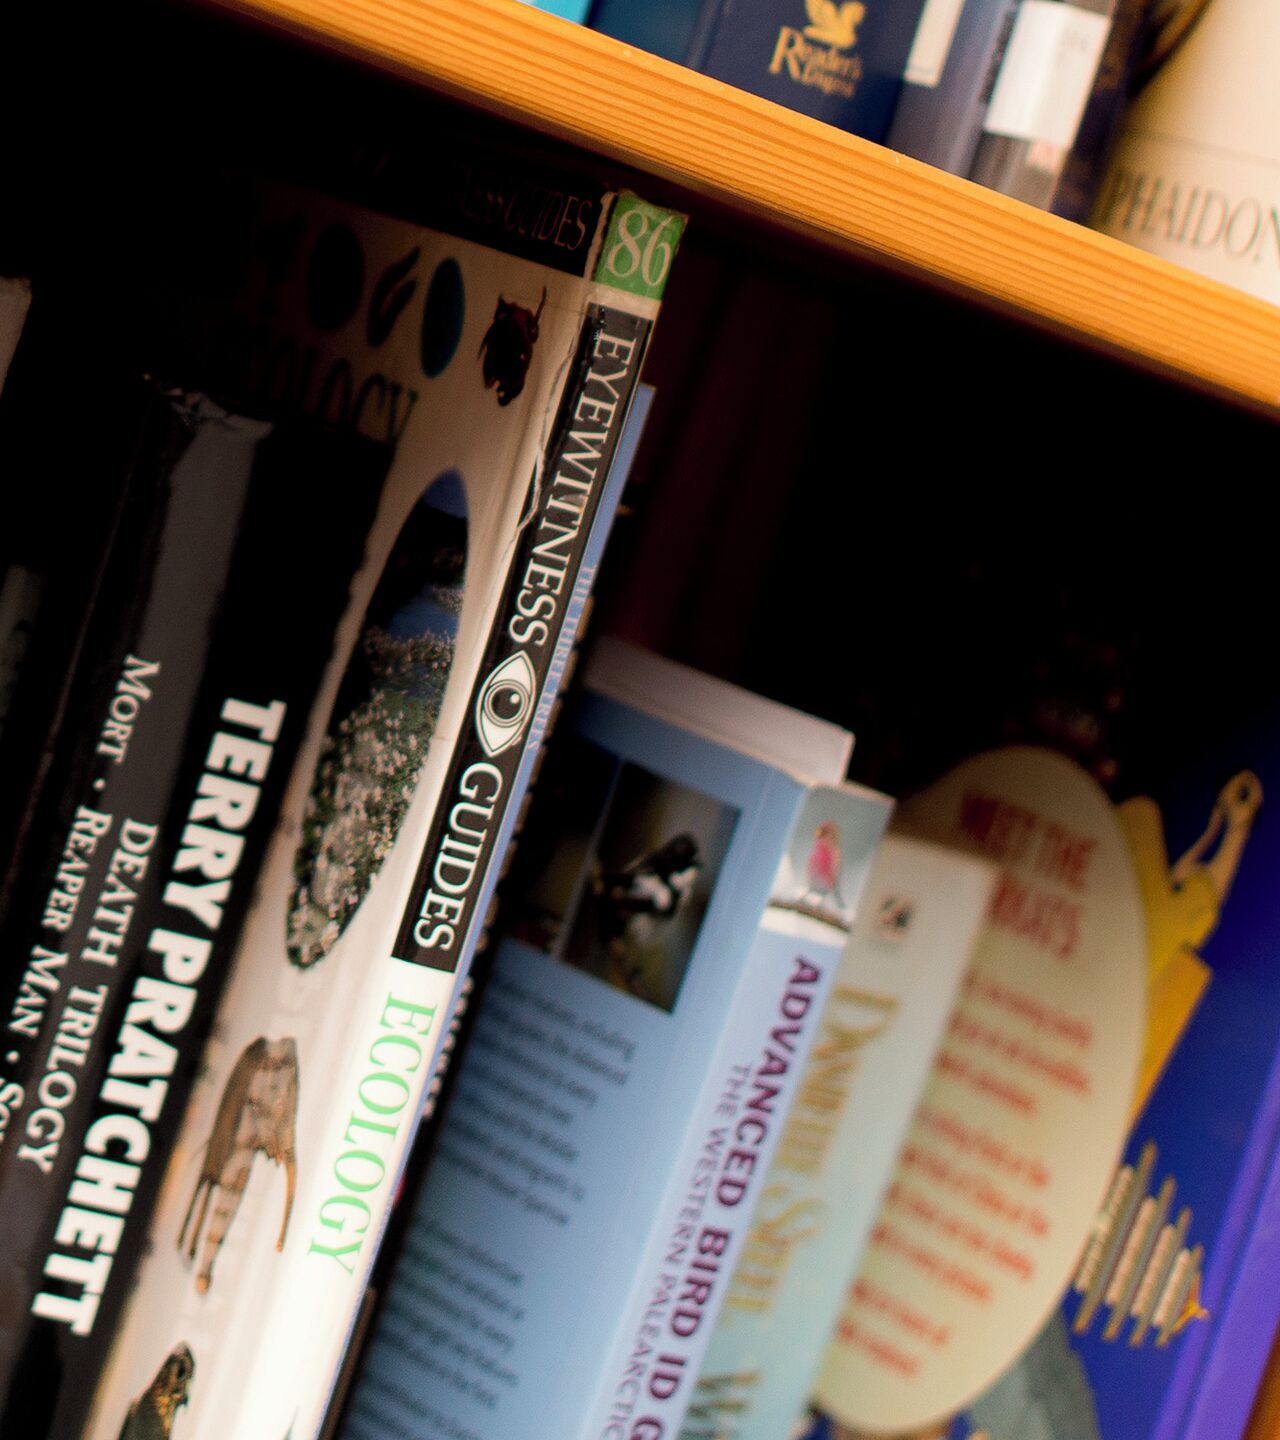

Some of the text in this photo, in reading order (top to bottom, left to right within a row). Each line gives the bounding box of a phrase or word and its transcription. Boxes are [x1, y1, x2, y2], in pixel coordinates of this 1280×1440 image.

[604, 208, 673, 287] 86
[413, 328, 639, 951] EYEWITNESS GUIDES
[17, 817, 159, 1173] DEATH TRILOGY
[31, 696, 287, 1336] TERRY PRATCHETT
[714, 1063, 752, 1118] THE
[716, 954, 822, 1210] ADVANCED
[307, 990, 439, 1277] ECOLOGY
[665, 1127, 728, 1263] WESTERN
[648, 1353, 688, 1401] ID
[670, 1226, 732, 1339] BIRD
